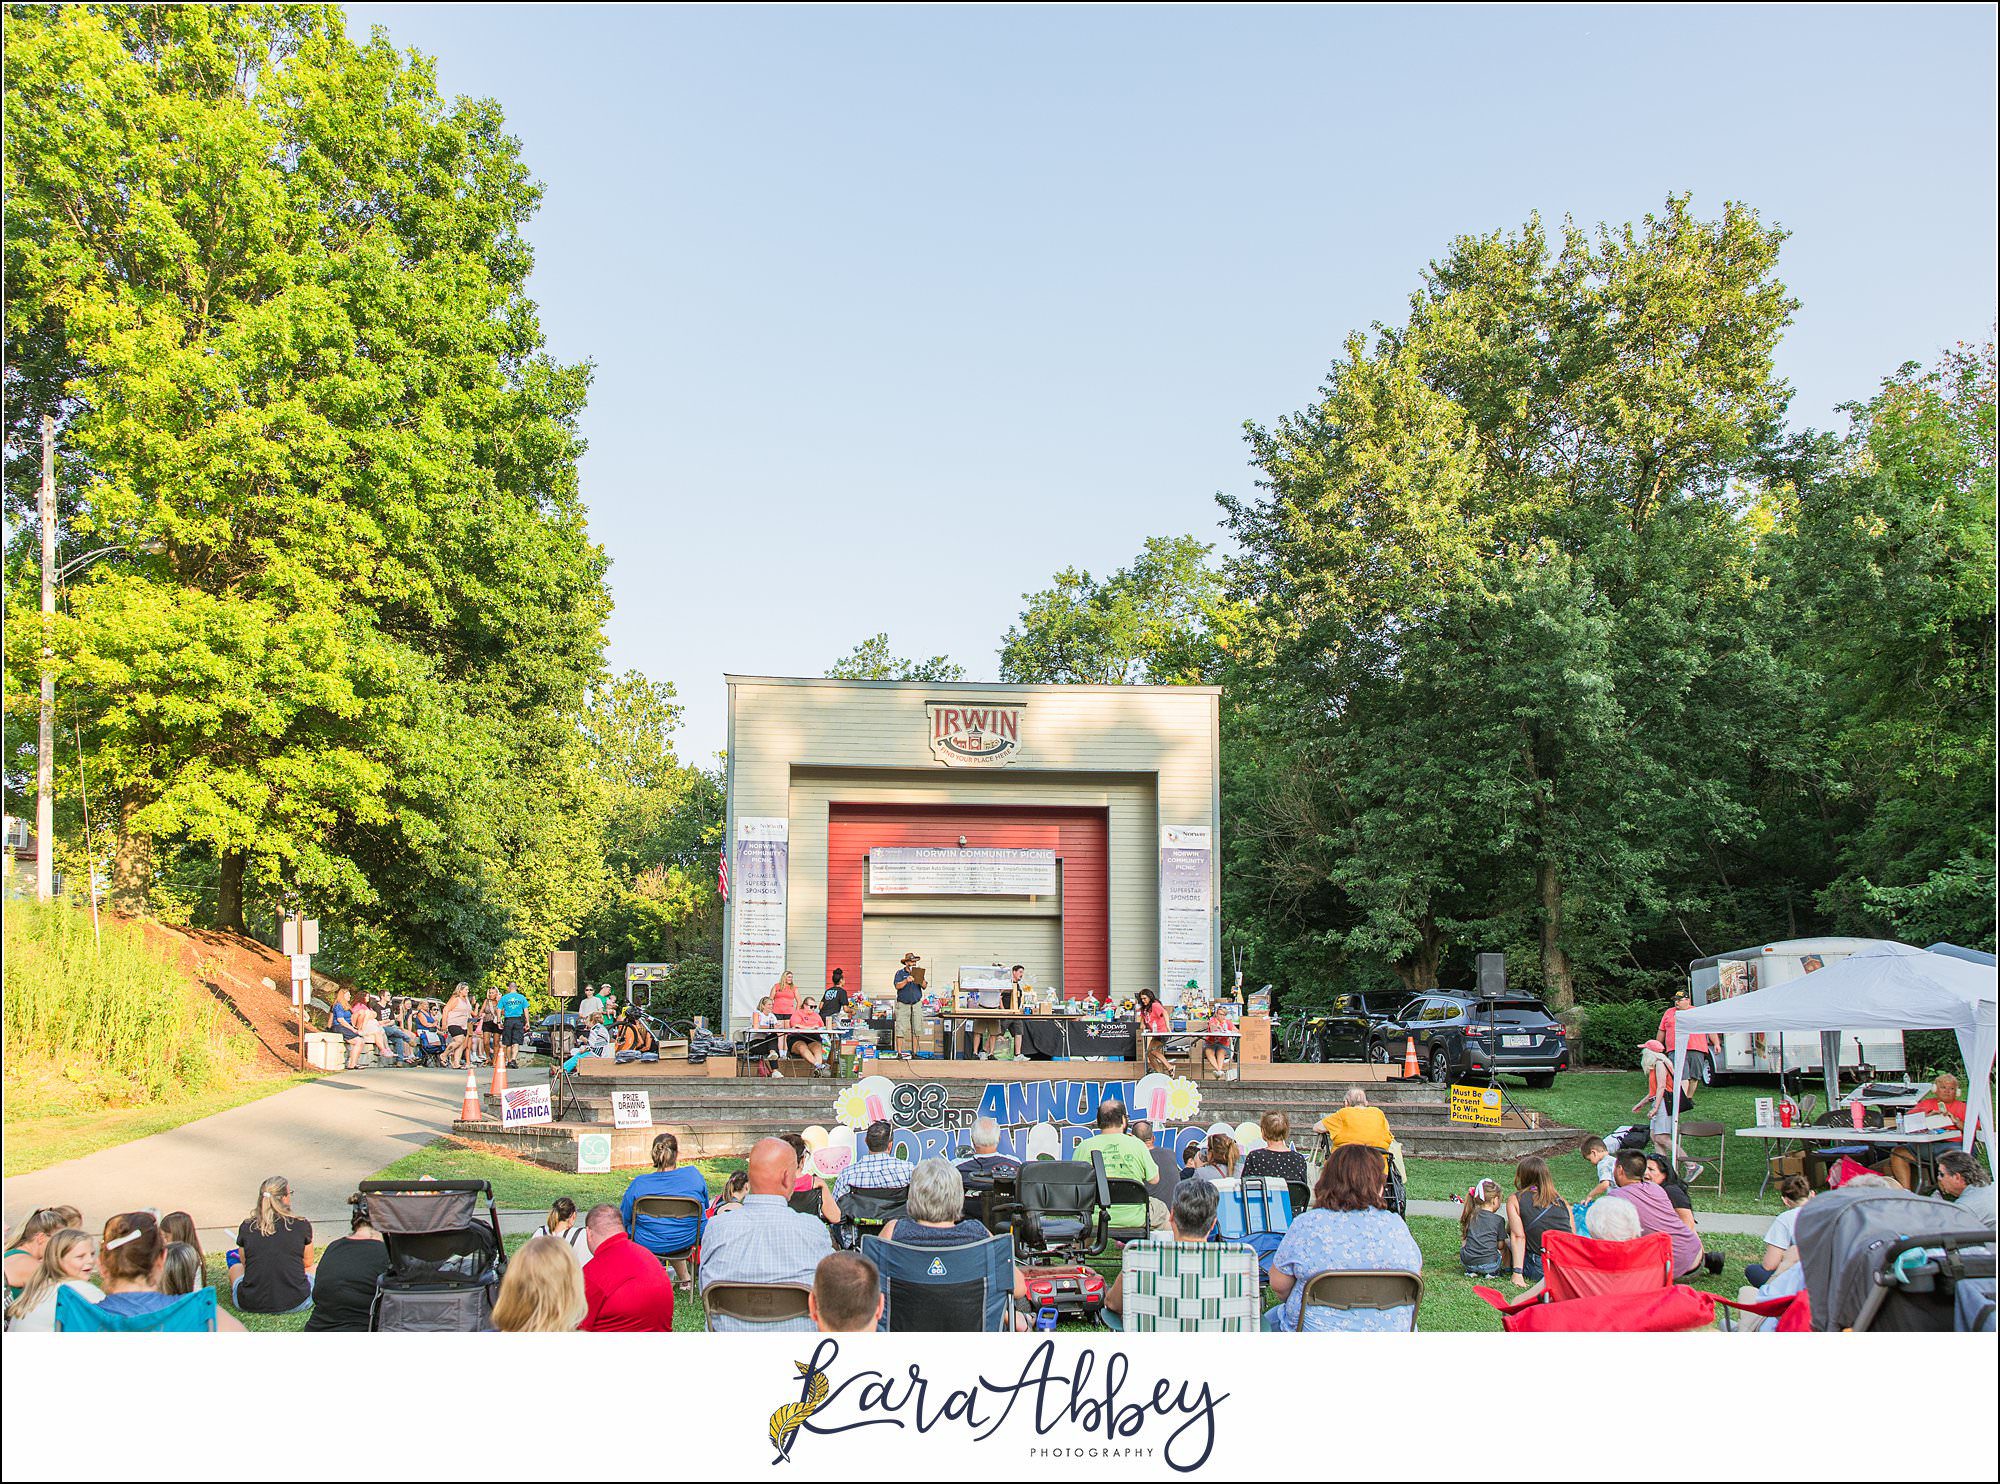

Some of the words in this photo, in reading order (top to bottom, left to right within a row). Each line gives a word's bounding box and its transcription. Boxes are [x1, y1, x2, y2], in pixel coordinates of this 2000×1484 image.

[934, 708, 1018, 741] IRWIN
[940, 747, 955, 758] FIND
[955, 755, 973, 763] YOUR
[995, 748, 1012, 760] HERE
[915, 849, 957, 858] NORWIN
[959, 850, 1018, 858] COMMUNITY
[1020, 851, 1053, 859] PICNIC
[622, 1093, 639, 1101] PRIZE
[1452, 1088, 1470, 1097] Must
[1472, 1090, 1482, 1098] Be
[618, 1101, 646, 1110] DRAWING
[976, 1080, 1148, 1126] ANNUAL
[1452, 1096, 1480, 1105] Present
[506, 1105, 550, 1121] AMERICA
[627, 1109, 639, 1118] 7:00
[1464, 1105, 1478, 1113] Win
[1452, 1112, 1473, 1121] Picnic
[1475, 1114, 1500, 1124] Prizes!
